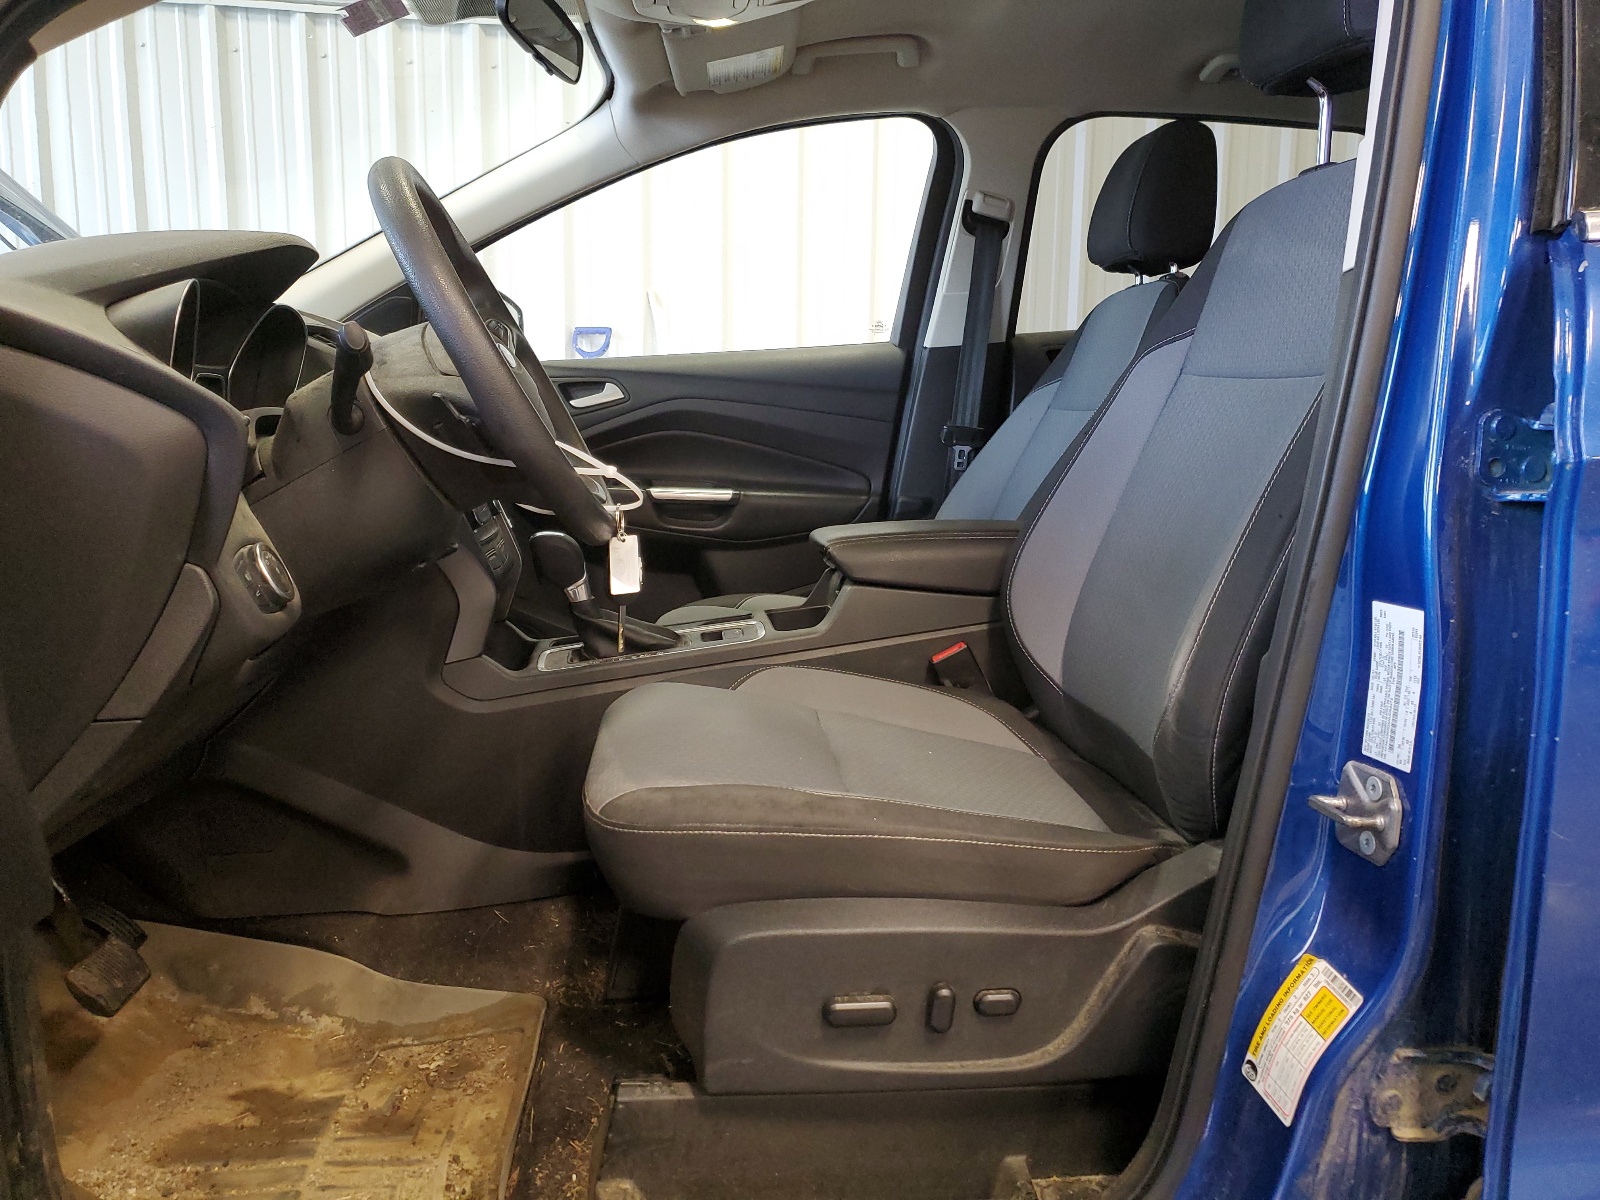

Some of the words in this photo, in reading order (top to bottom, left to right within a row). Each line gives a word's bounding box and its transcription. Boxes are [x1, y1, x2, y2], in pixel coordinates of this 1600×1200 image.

[1251, 1041, 1260, 1056] TIRE
[1259, 1026, 1267, 1041] AND
[1265, 997, 1284, 1026] LOADING
[1281, 957, 1314, 997] INFORMATION
